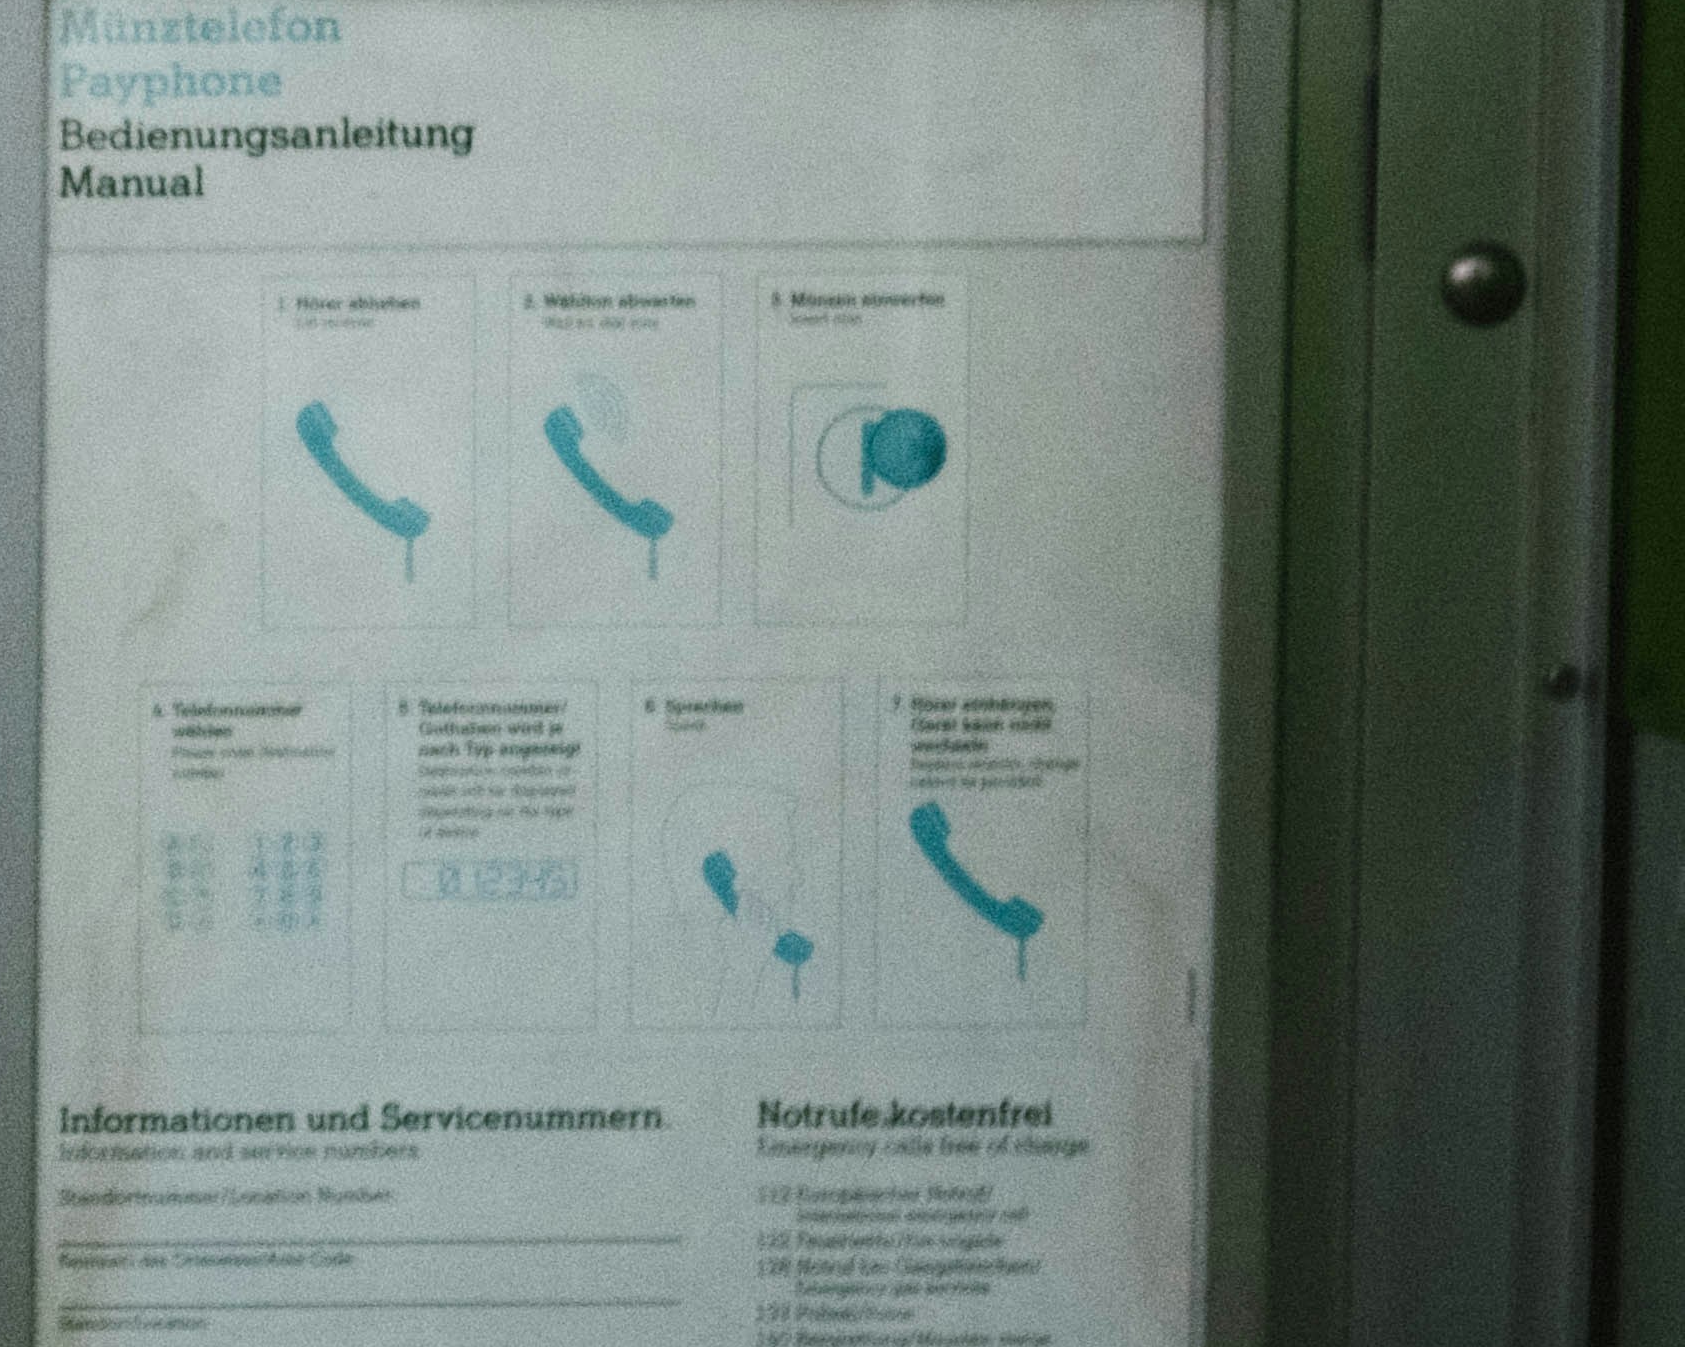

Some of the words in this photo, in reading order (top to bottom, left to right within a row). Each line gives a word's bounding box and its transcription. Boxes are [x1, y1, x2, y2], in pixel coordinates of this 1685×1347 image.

[59, 6, 341, 45] Münztelefon
[59, 63, 283, 108] Payphone
[59, 116, 475, 156] Bedienungsanleitung
[59, 165, 205, 198] Manual
[59, 1107, 294, 1135] Informationen
[306, 1105, 370, 1133] und
[379, 1102, 663, 1133] Servicenummern
